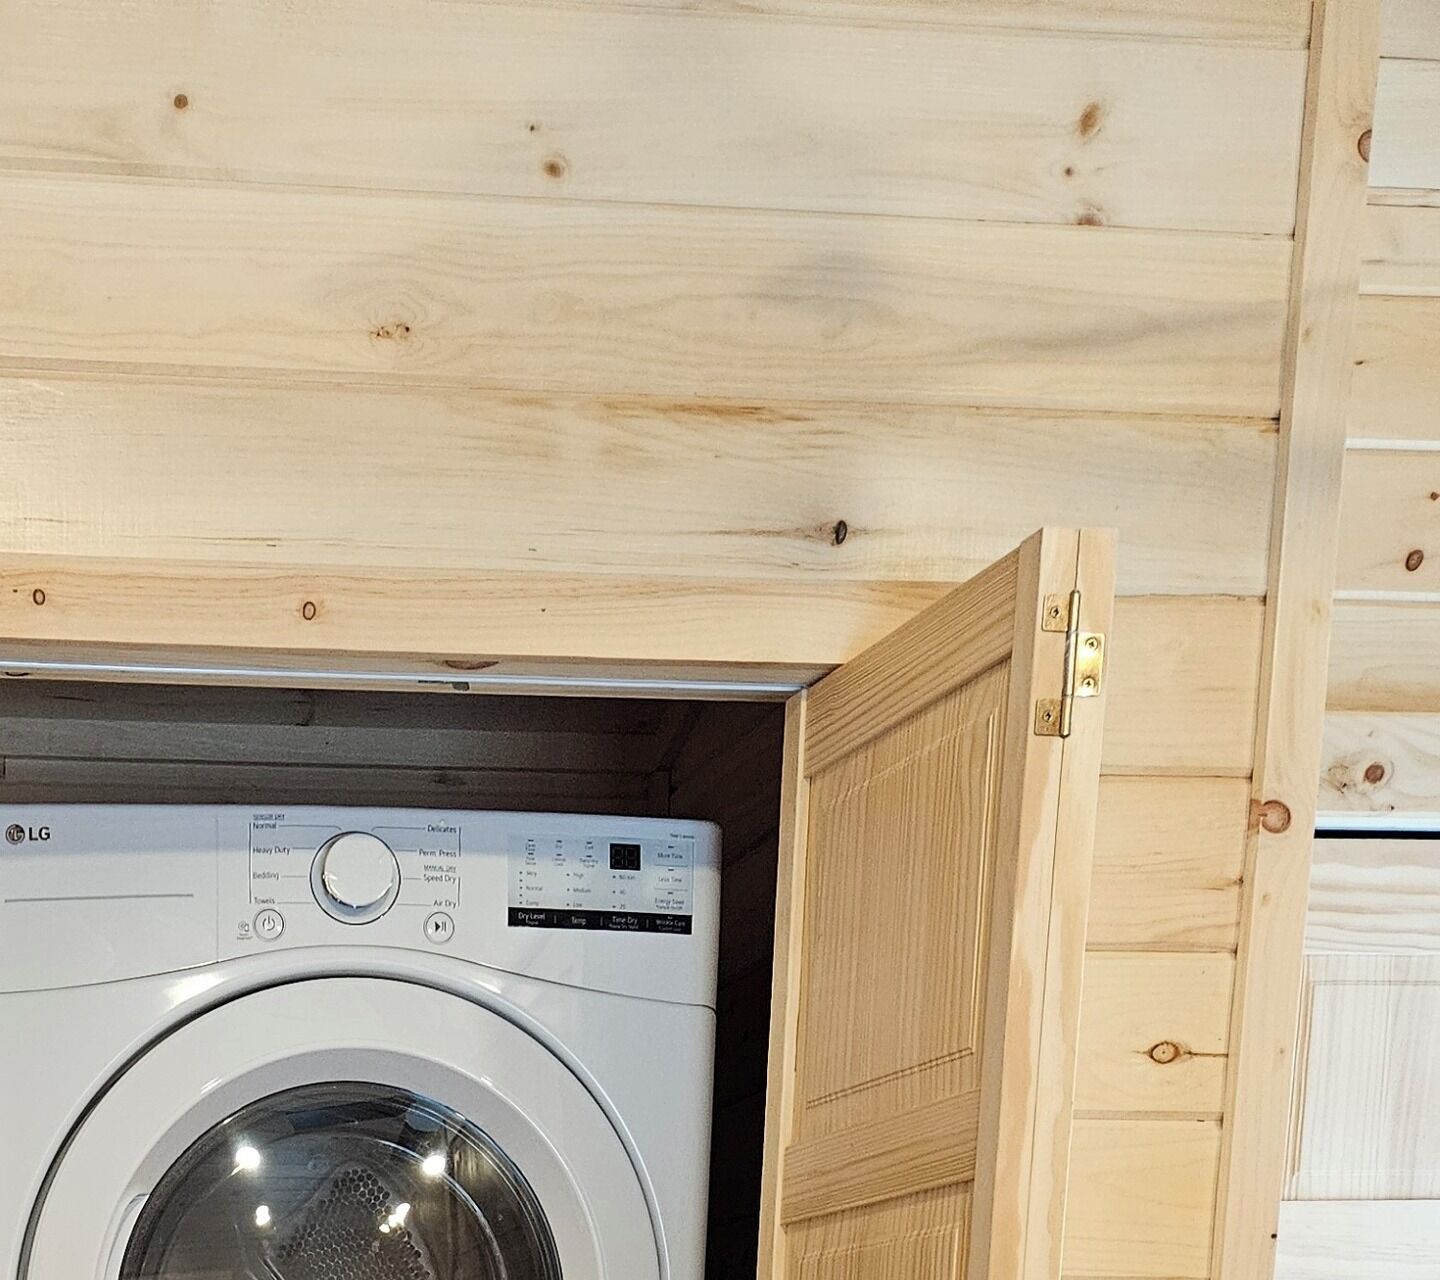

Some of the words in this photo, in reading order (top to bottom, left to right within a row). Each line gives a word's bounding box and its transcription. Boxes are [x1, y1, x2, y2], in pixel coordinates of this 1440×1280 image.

[28, 826, 51, 841] LG
[427, 824, 457, 834] Delicates
[274, 847, 291, 855] Duty
[439, 849, 457, 857] Press
[253, 872, 280, 880] Bedding
[424, 874, 441, 883] Speed
[441, 874, 457, 884] Dry
[442, 900, 456, 909] Dry
[518, 911, 529, 922] Dry
[529, 912, 545, 921] Level
[612, 916, 623, 924] Time
[624, 917, 638, 927] Dry
